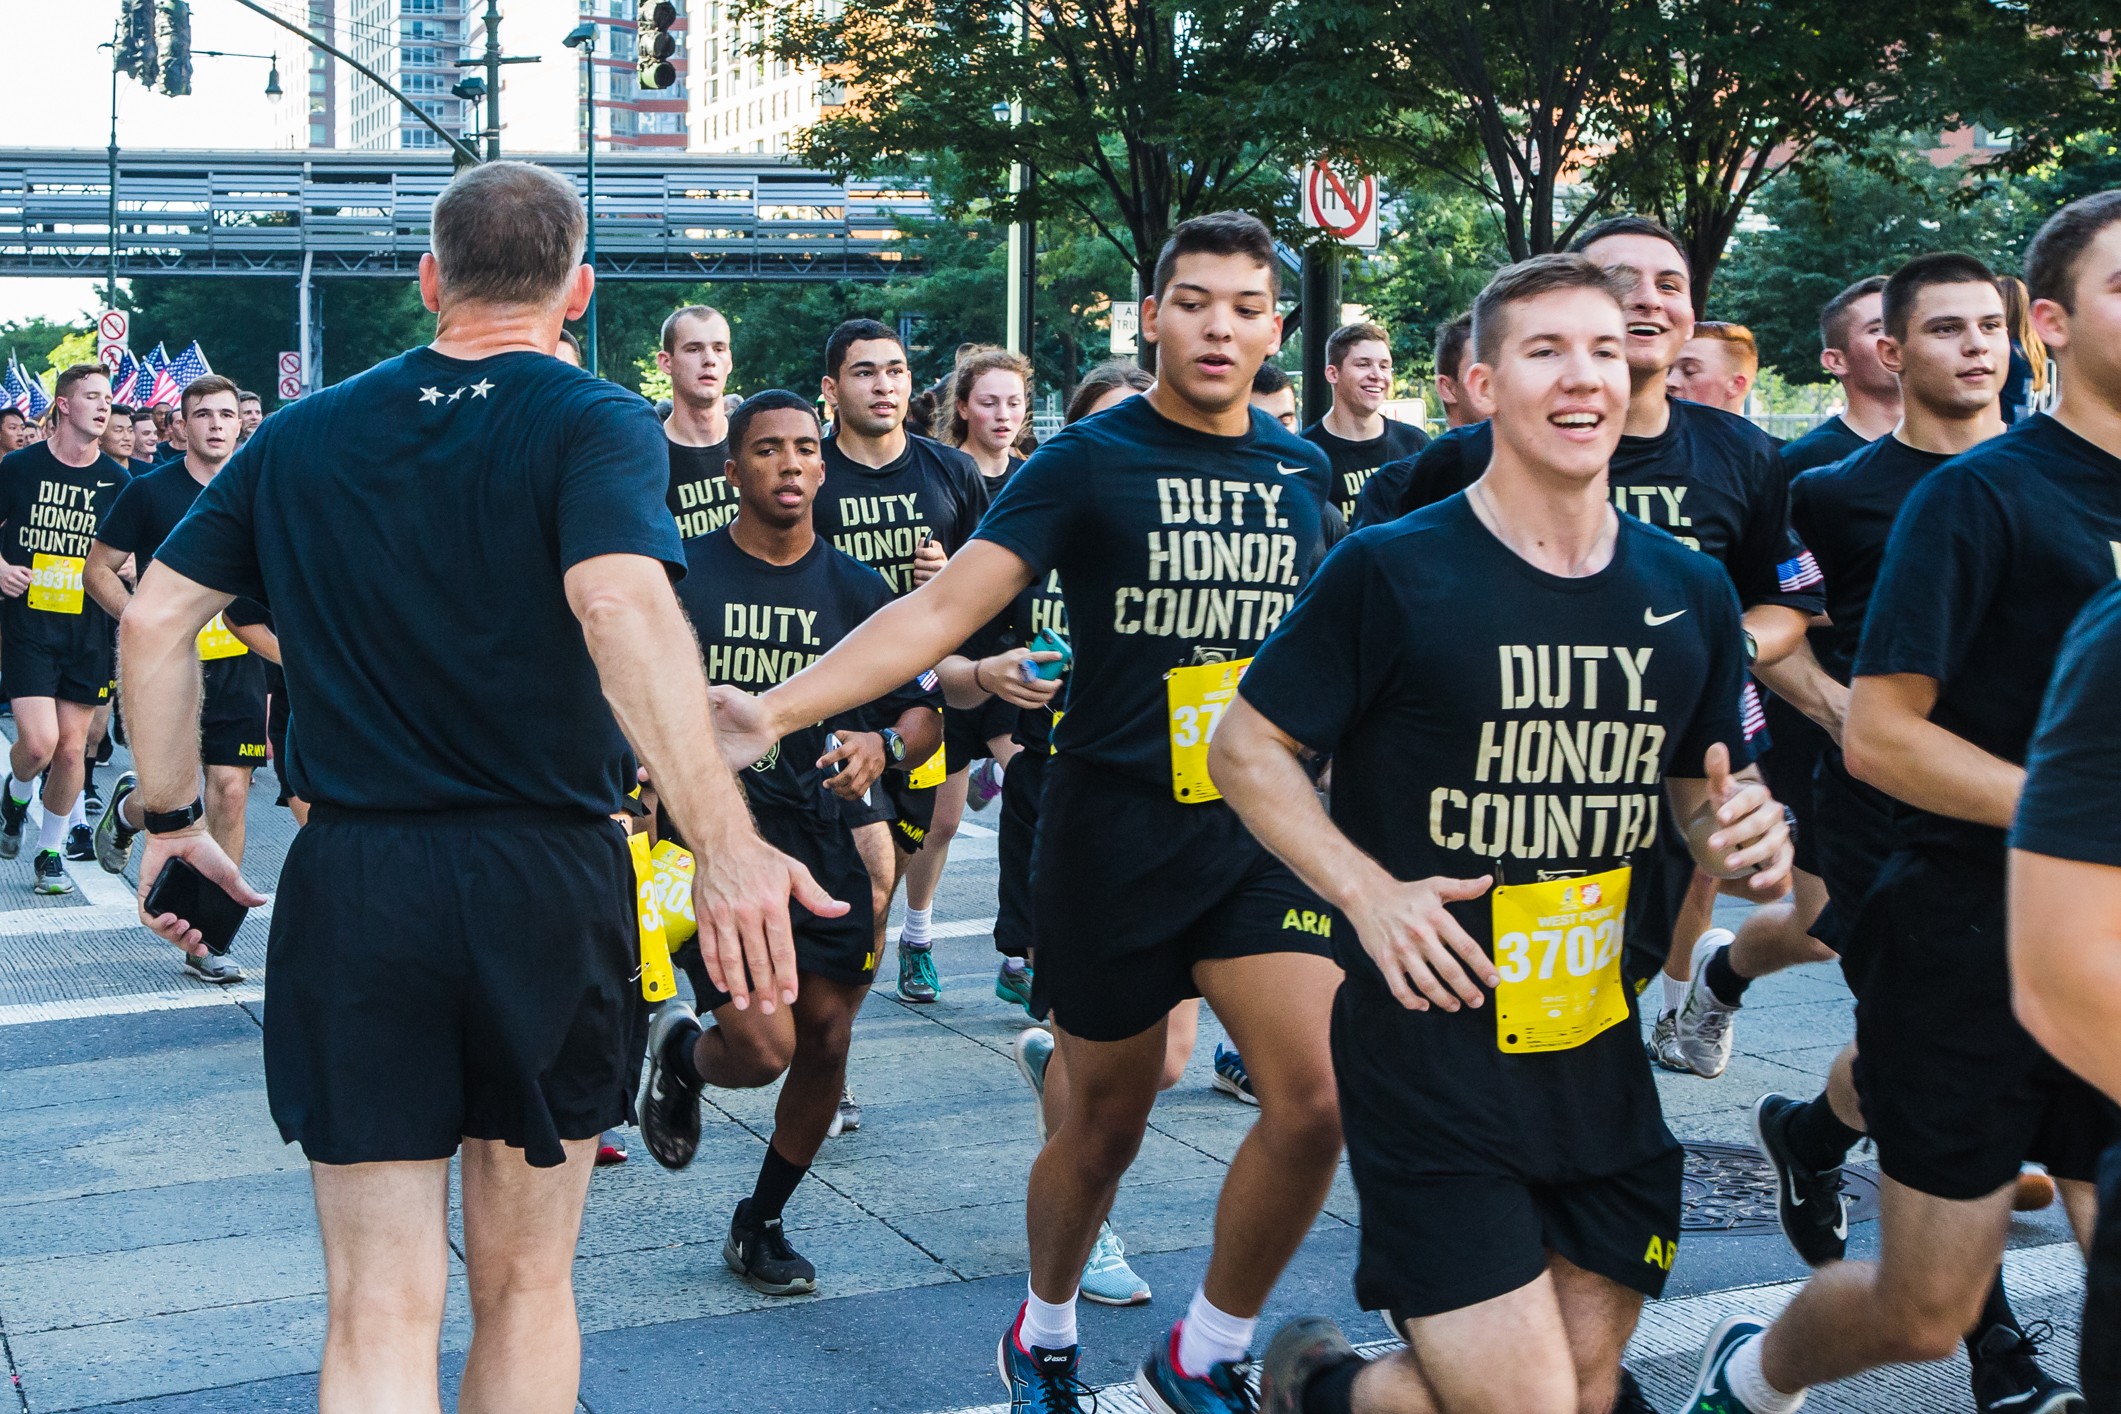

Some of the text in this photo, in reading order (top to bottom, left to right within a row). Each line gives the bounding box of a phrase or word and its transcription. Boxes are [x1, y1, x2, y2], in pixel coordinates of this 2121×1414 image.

[38, 480, 96, 512] DUTY.
[677, 475, 741, 509] DUT
[1156, 477, 1289, 529] DUTY.
[30, 503, 98, 536] HONOR.
[839, 492, 924, 527] DUTY.
[19, 526, 95, 556] COUNTR
[1147, 530, 1300, 587] HONOR.
[724, 602, 821, 646] DUTY.
[1498, 644, 1658, 712] DUTY.
[238, 743, 266, 757] ARMY
[1537, 912, 1578, 927] WEST
[1579, 905, 1615, 924] POINT
